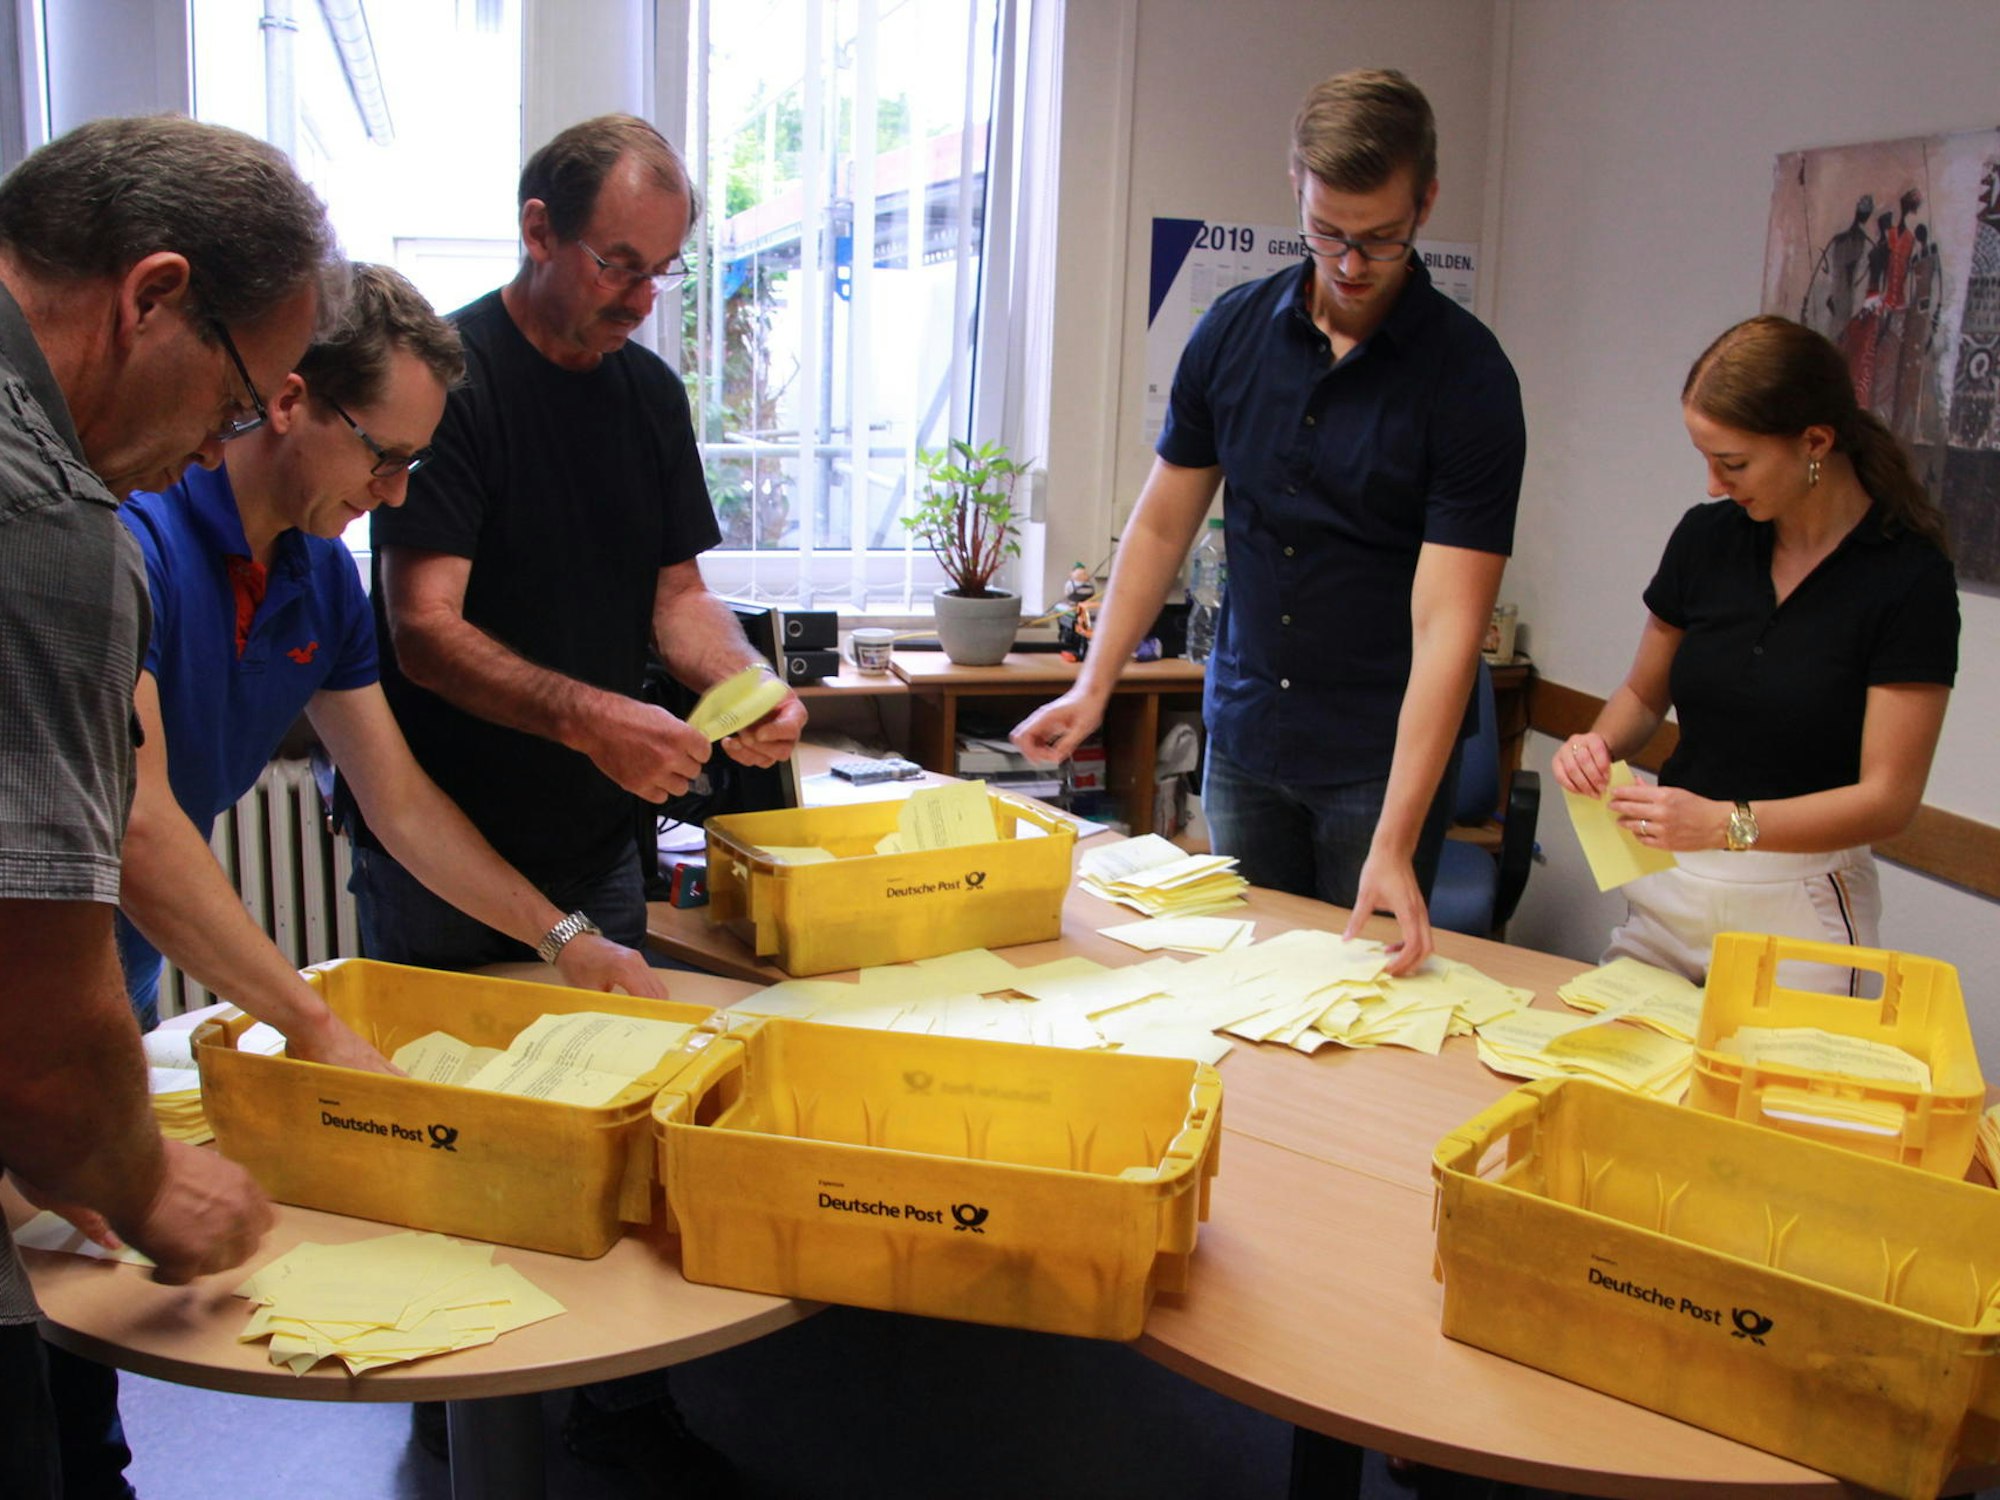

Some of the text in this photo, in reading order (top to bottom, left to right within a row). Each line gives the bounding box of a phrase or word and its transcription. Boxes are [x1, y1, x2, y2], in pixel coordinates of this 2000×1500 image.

[1194, 225, 1475, 271] 2019 GEME BILDEN.
[886, 881, 961, 898] Deutsche Post
[321, 1111, 424, 1142] Deutsche Post
[818, 1193, 943, 1224] Deutsche Post
[1588, 1267, 1722, 1326] Deutsche Post
